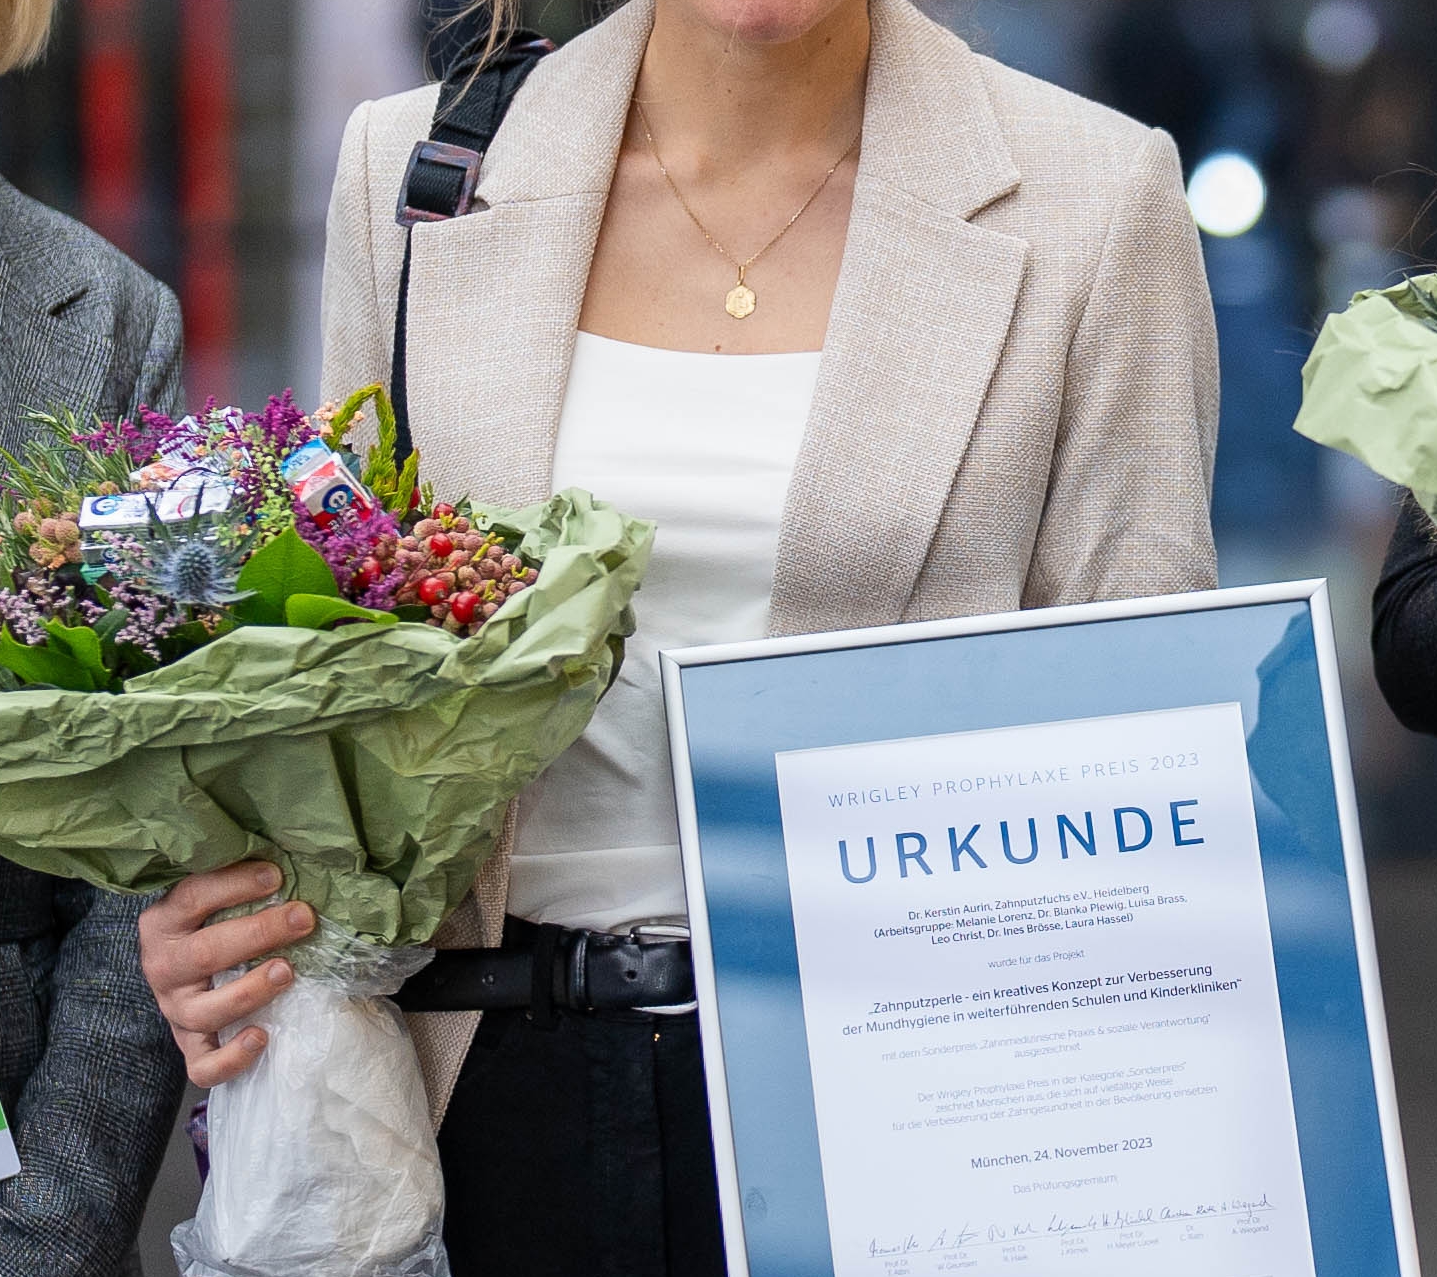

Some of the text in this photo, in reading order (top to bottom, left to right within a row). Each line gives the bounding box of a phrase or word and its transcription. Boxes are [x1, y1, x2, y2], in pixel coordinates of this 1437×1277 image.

[827, 752, 1198, 807] WRIGLEY PROPHYLAXE PREIS 2023
[838, 798, 1204, 883] URKUNDE
[873, 921, 954, 938] (Arbeitsgruppe:
[955, 915, 996, 928] Melanie
[1037, 909, 1051, 918] Dr.
[1053, 905, 1087, 916] Blanka
[1128, 897, 1155, 908] Luisa
[907, 911, 922, 920] Dr.
[924, 906, 960, 918] Kerstin
[994, 893, 1070, 909] Zahnputzfuchs
[1093, 885, 1149, 898] Heidelberg
[931, 935, 950, 945] Leo
[986, 928, 1001, 938] Dr.
[1003, 926, 1024, 936] Ines
[1064, 918, 1094, 928] Laura
[1096, 912, 1133, 925] Hassel)
[971, 989, 990, 1001] ein
[993, 984, 1049, 999] kreatives
[1051, 976, 1102, 992] Konzept
[1104, 975, 1125, 985] zur
[1126, 965, 1212, 982] Verbesserung
[842, 1025, 862, 1035] der
[866, 1014, 950, 1032] Mundhygiene
[953, 1011, 964, 1022] in
[966, 999, 1069, 1019] weiterführenden
[1071, 993, 1120, 1007] Schulen
[1123, 988, 1147, 1001] und
[1033, 1149, 1051, 1161] 24.
[1054, 1142, 1118, 1158] November
[1121, 1136, 1152, 1150] 2023
